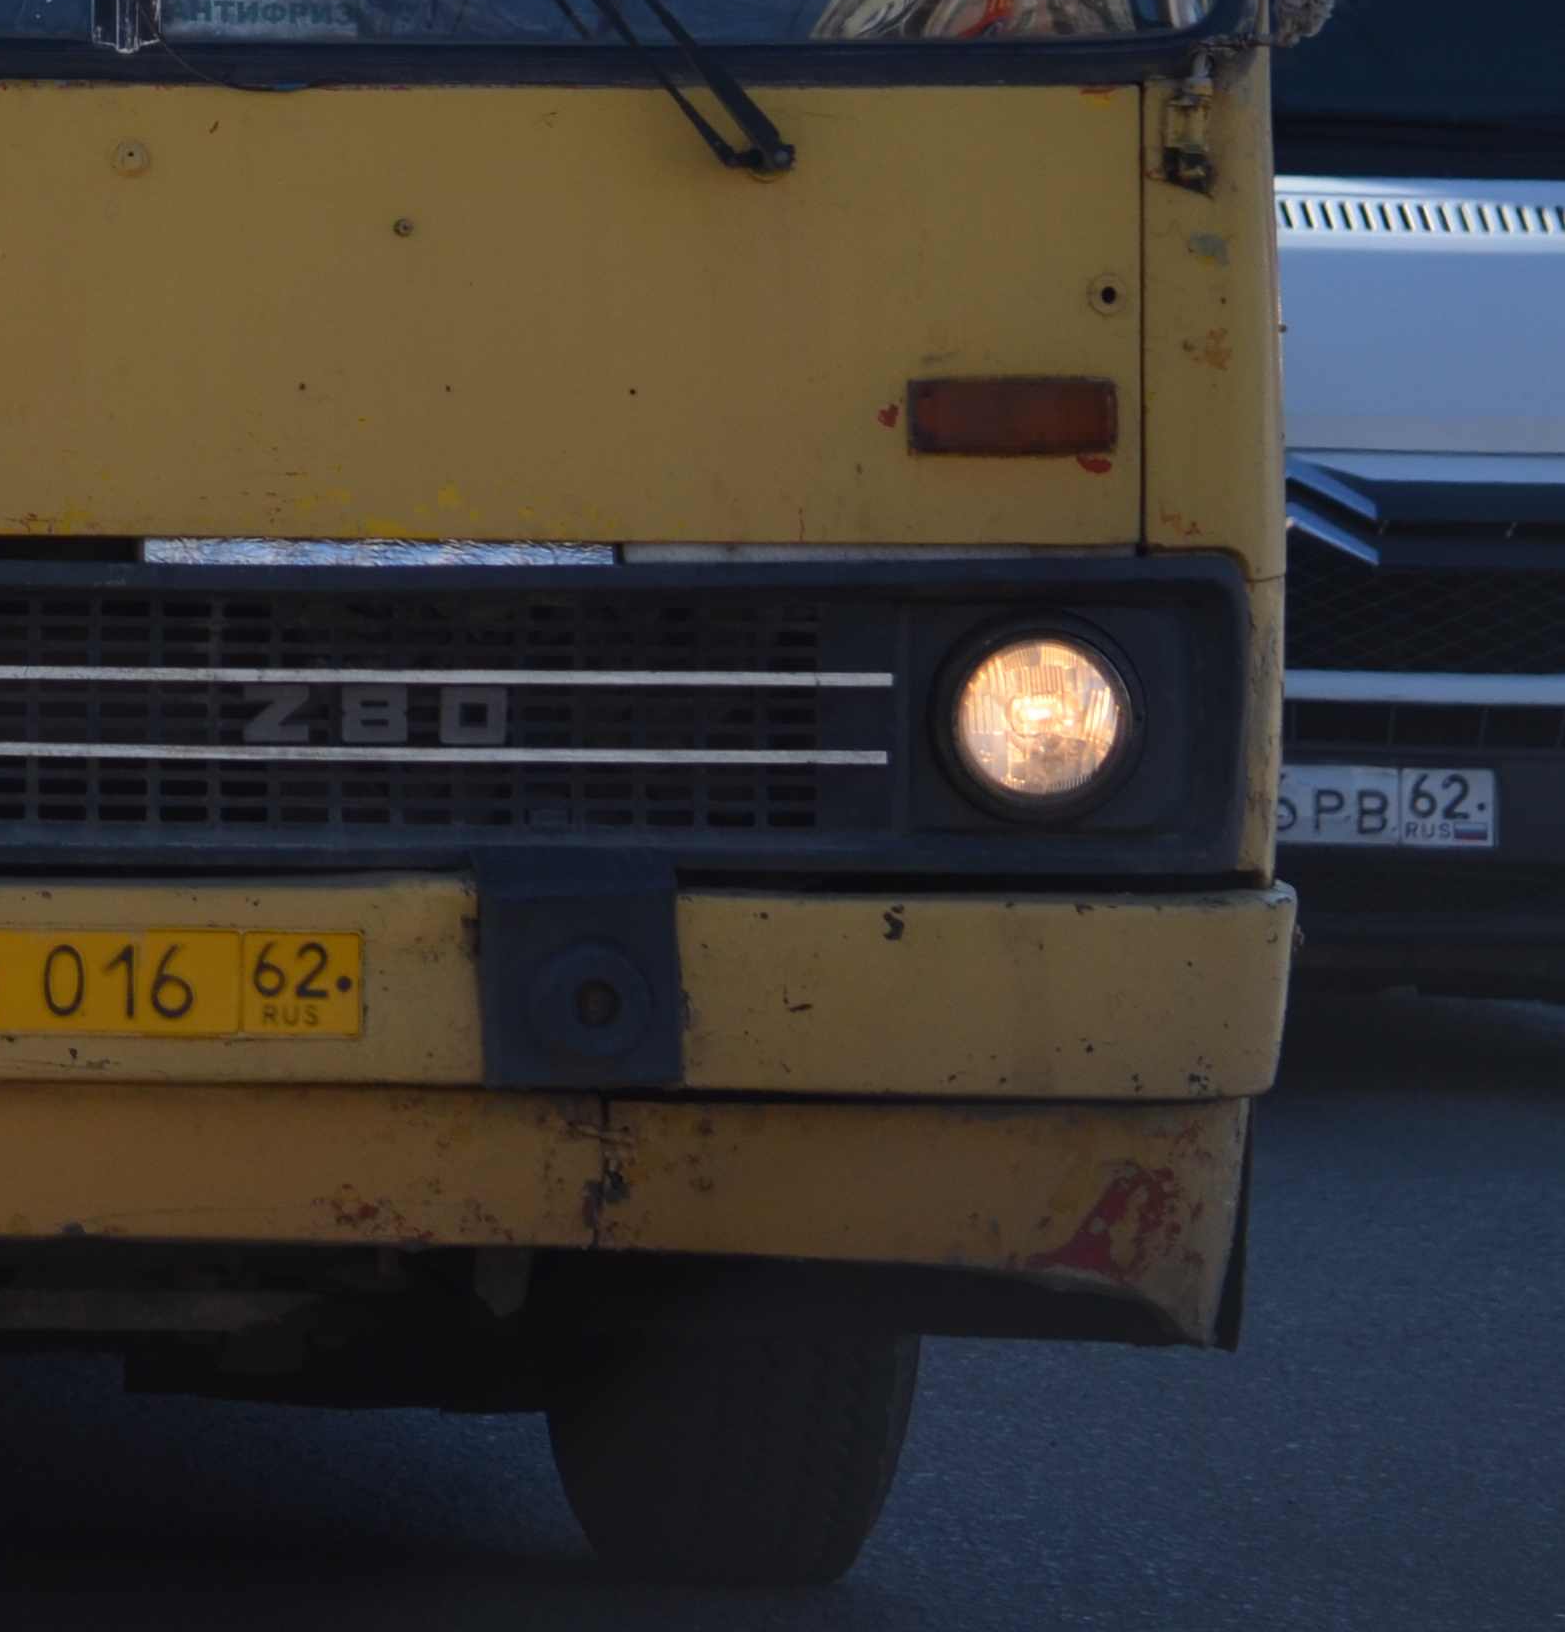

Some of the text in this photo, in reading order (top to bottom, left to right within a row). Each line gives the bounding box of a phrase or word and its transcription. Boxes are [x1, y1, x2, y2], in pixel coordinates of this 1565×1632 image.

[1409, 773, 1470, 820] 62
[1404, 821, 1452, 840] RUS
[42, 942, 195, 1020] 016
[252, 940, 330, 1000] 62
[261, 1002, 321, 1028] RUS
